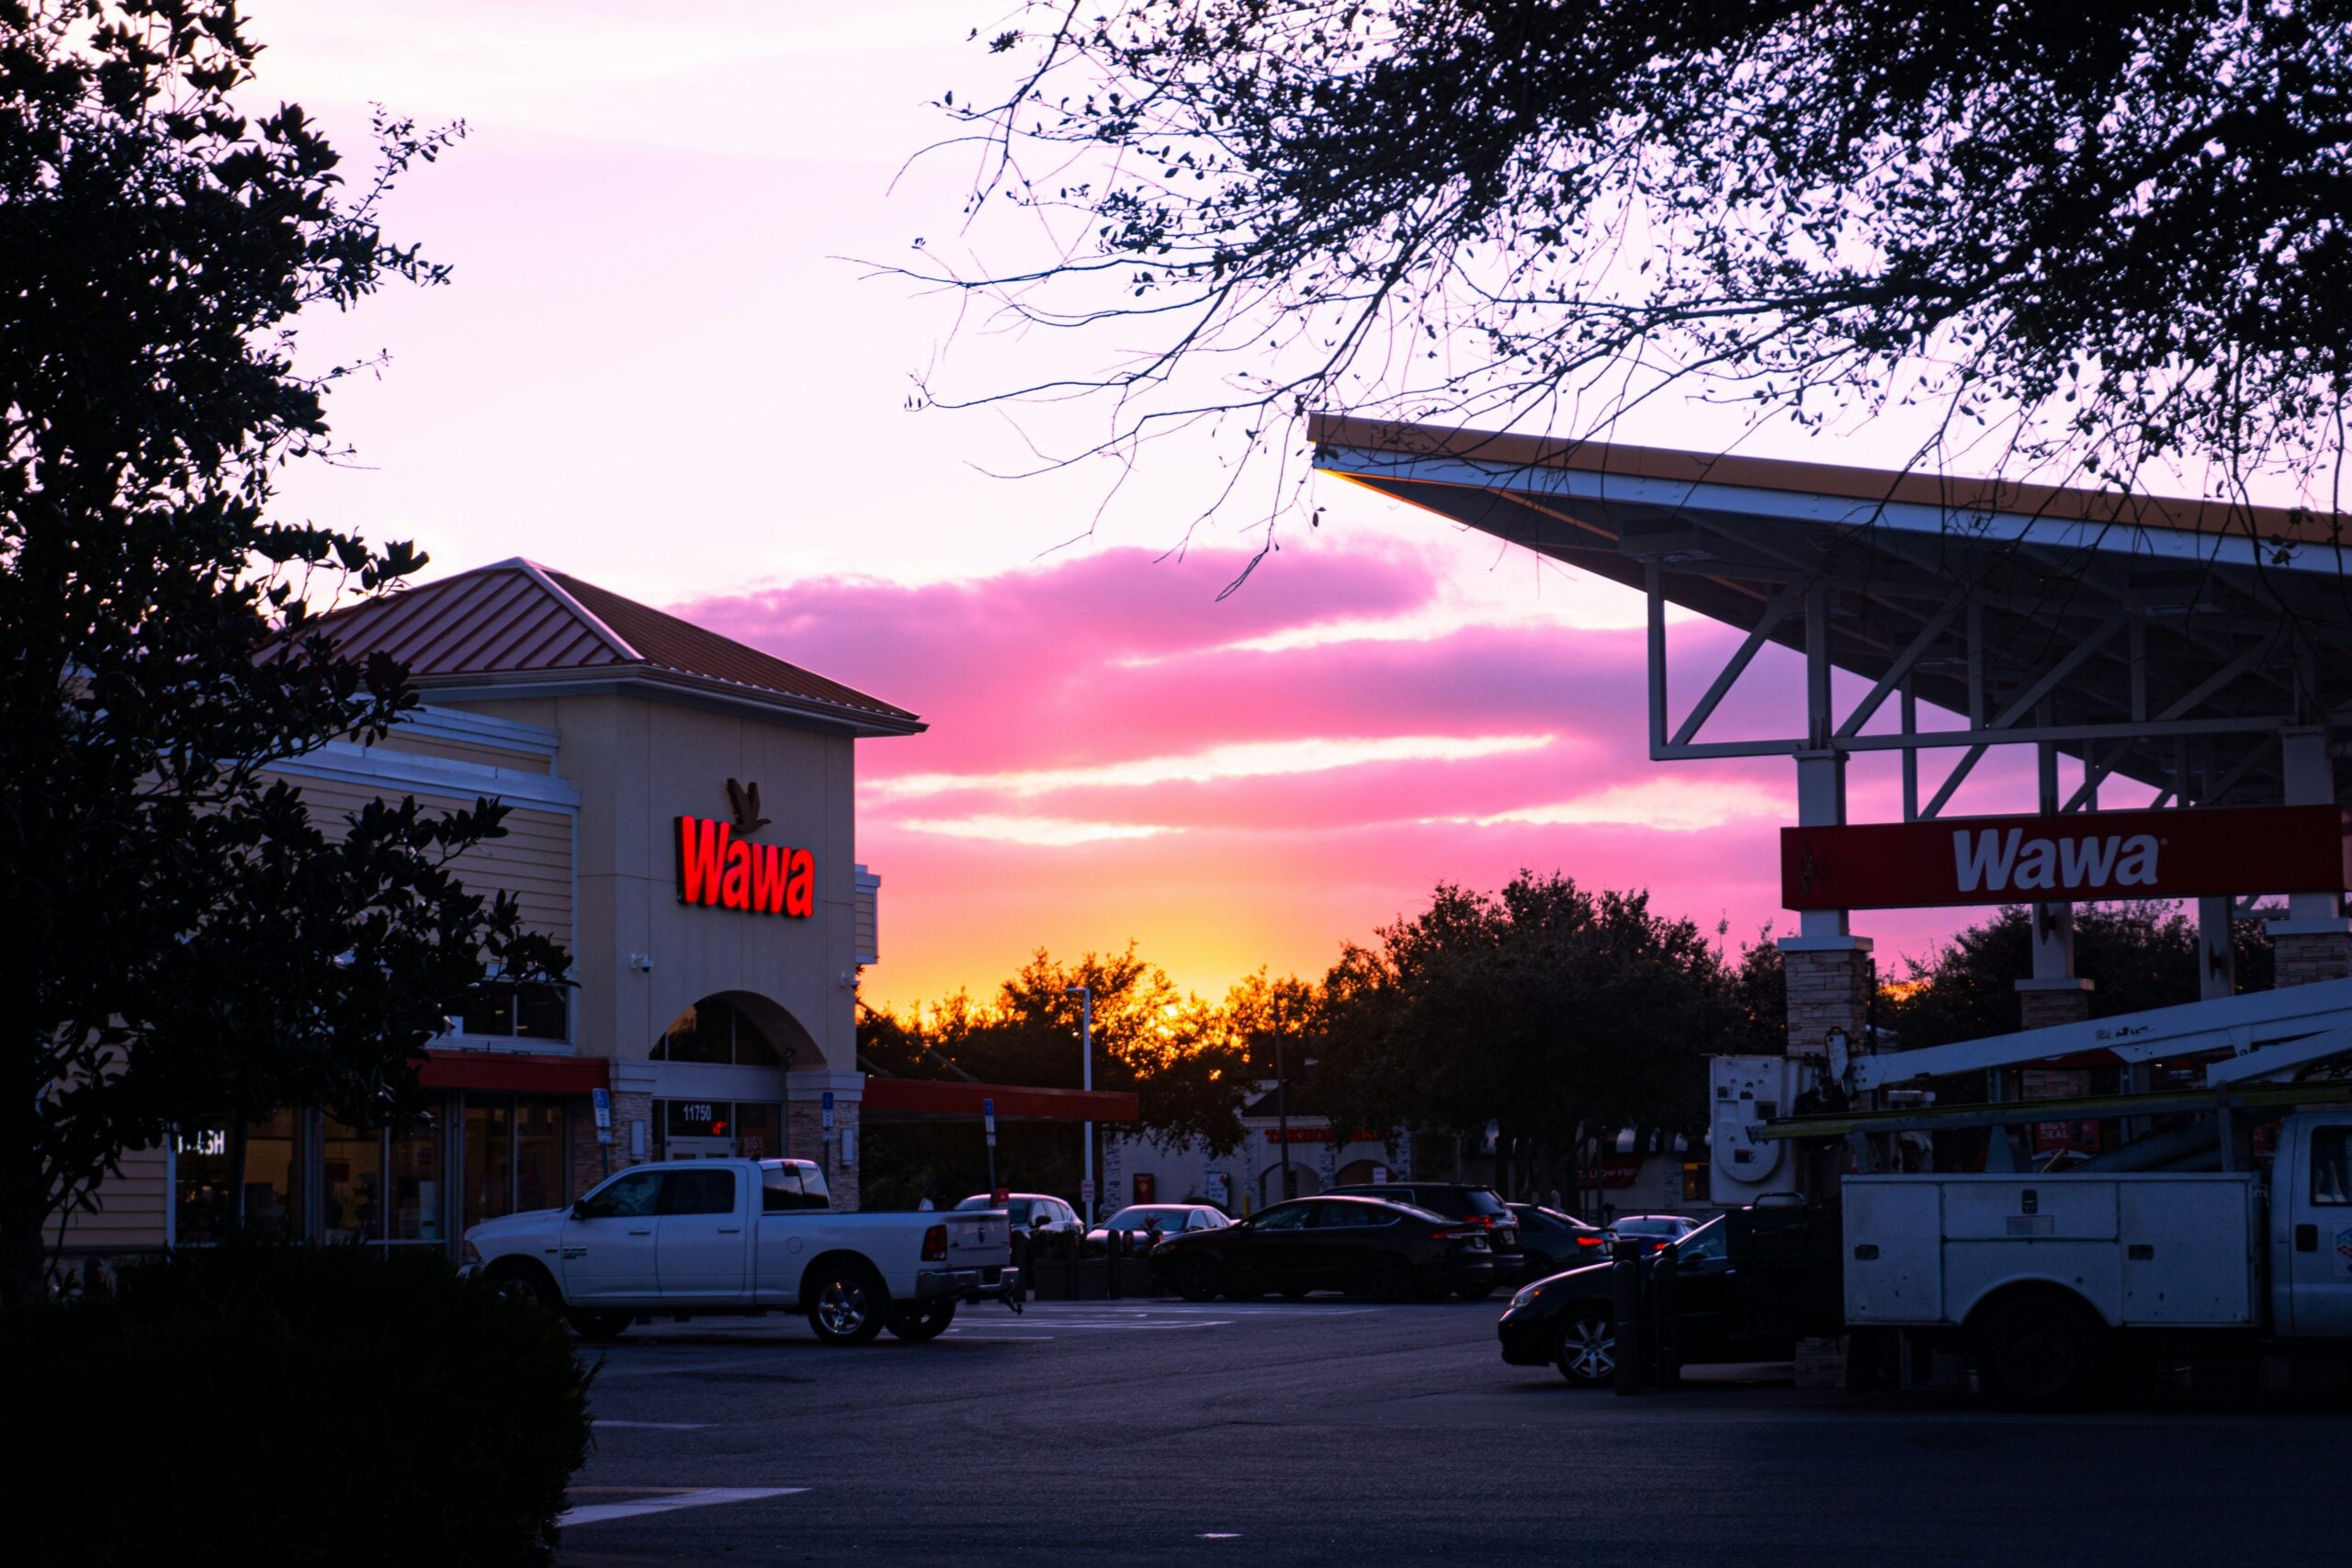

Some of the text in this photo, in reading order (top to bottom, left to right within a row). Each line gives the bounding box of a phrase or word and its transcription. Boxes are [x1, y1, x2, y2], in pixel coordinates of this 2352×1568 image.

[676, 815, 815, 918] Wawa
[1952, 827, 2160, 892] Wawa
[684, 1103, 712, 1122] 11750
